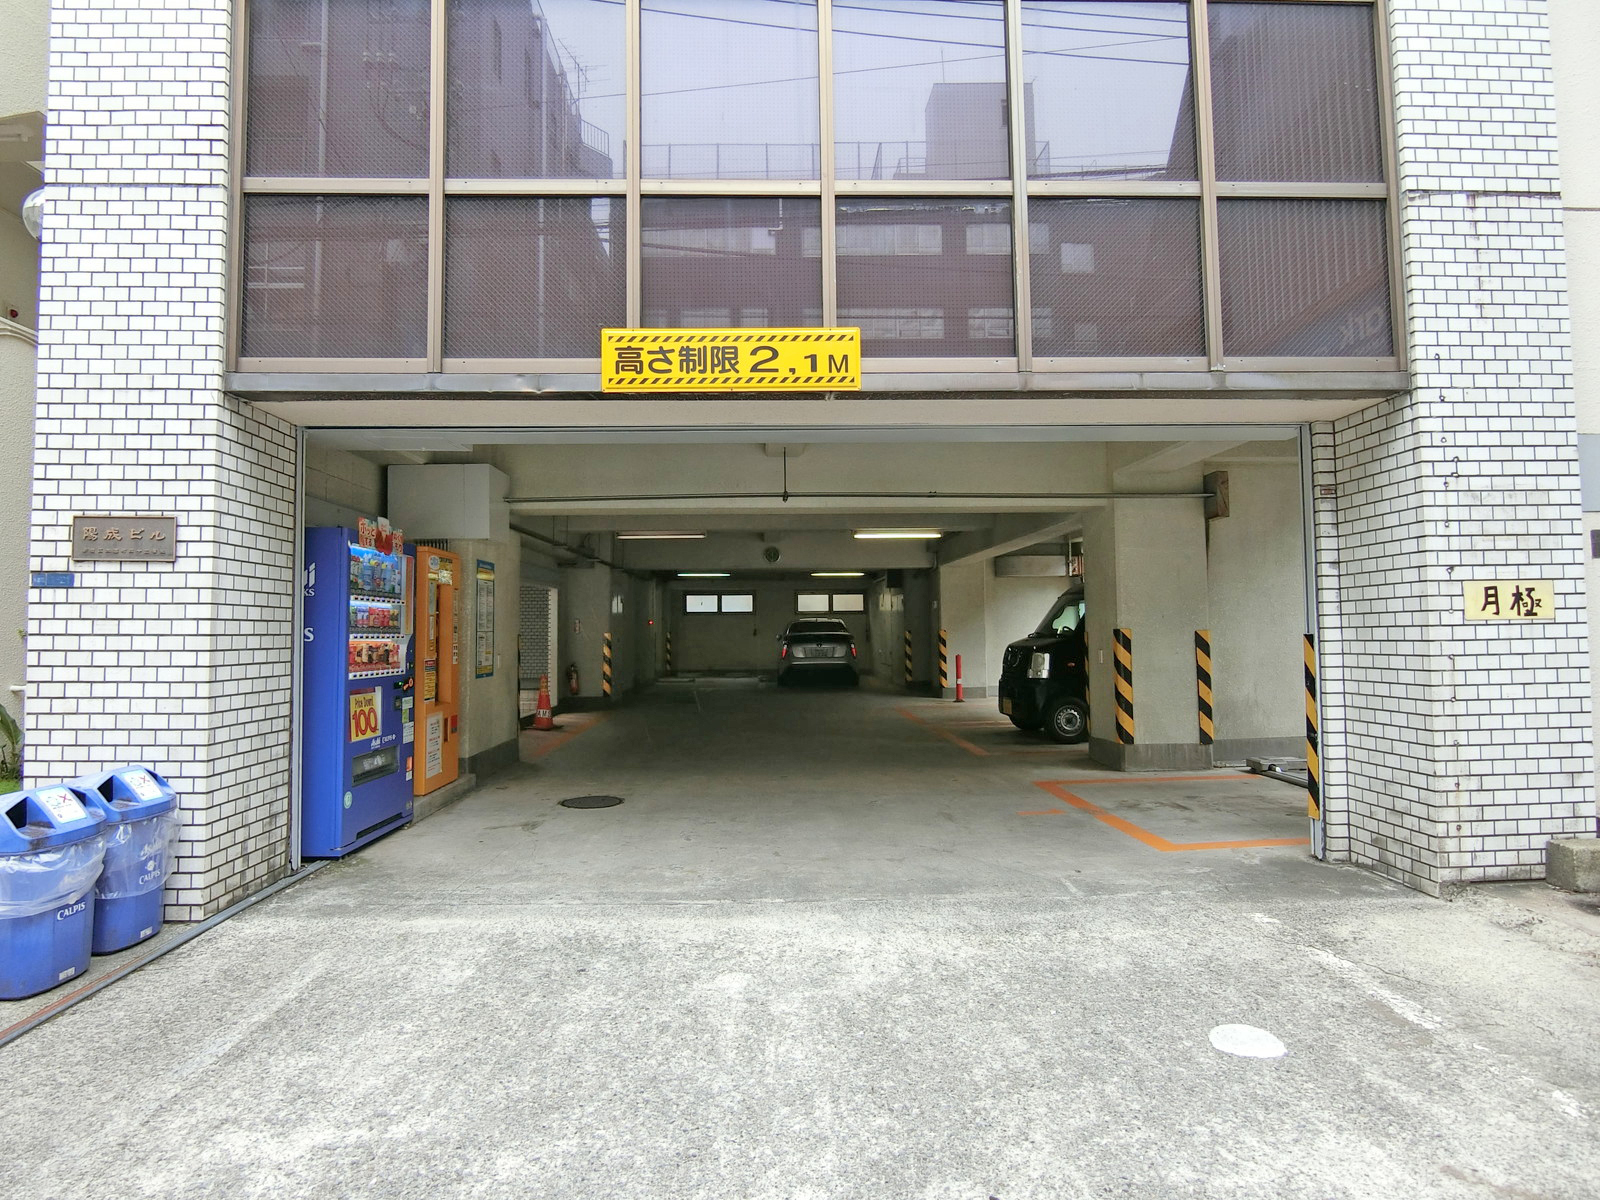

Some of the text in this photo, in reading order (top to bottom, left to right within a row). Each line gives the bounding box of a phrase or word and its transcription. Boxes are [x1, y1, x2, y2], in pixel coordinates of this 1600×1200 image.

[1481, 585, 1542, 617] 月極
[352, 707, 378, 737] 100
[57, 901, 86, 920] CALPIS
